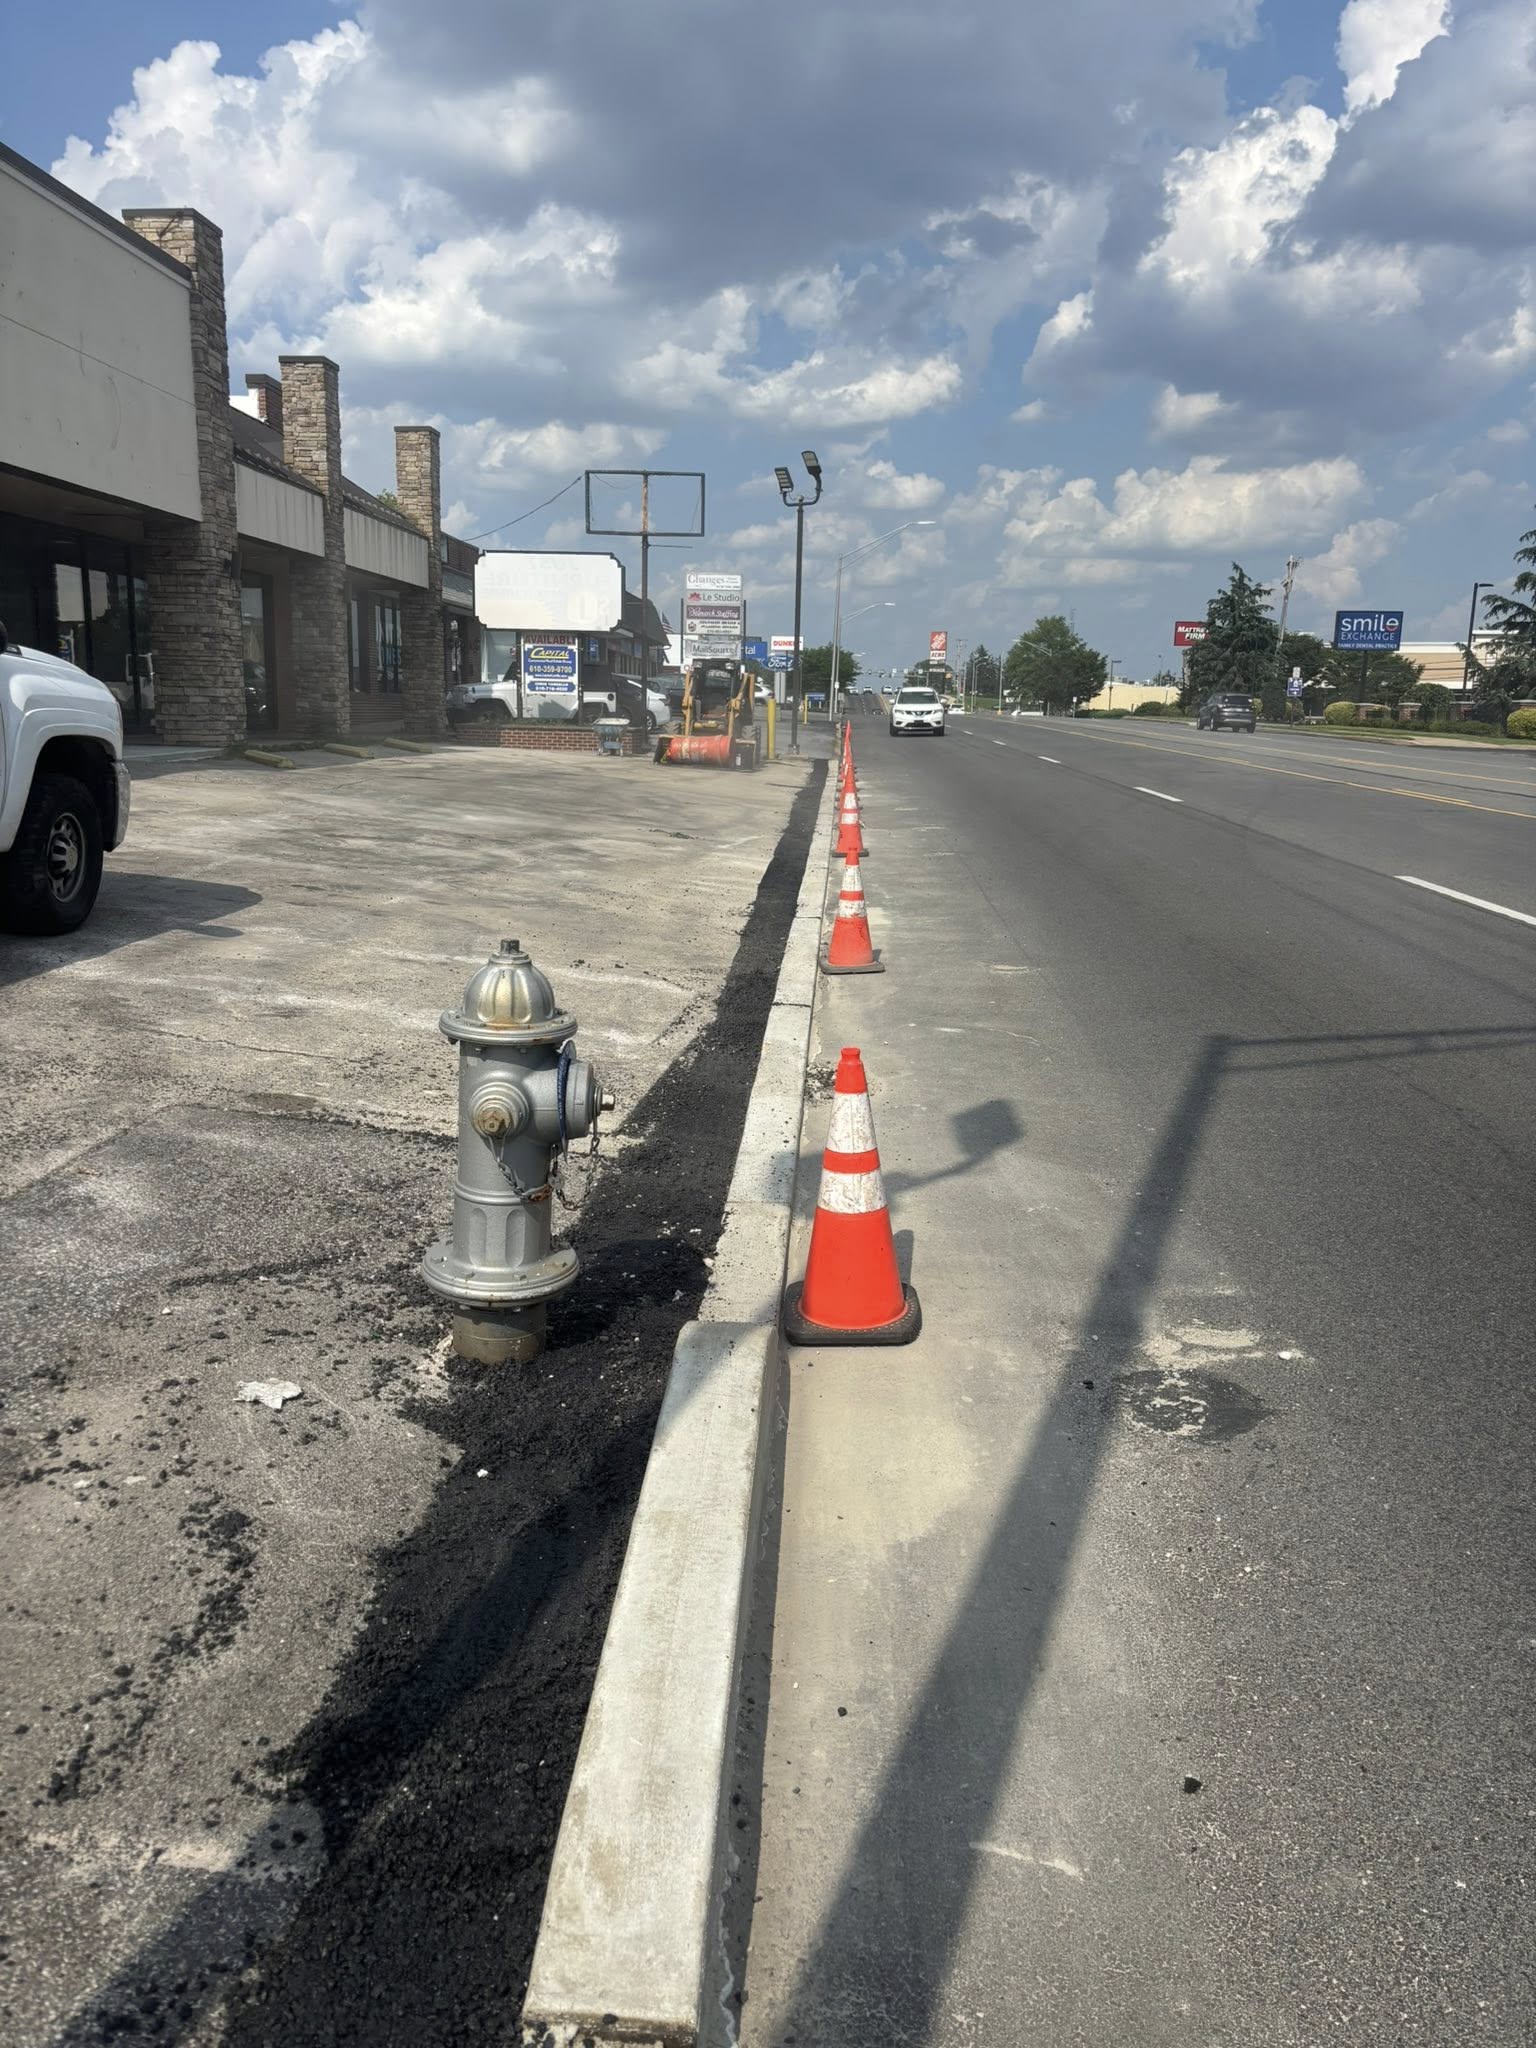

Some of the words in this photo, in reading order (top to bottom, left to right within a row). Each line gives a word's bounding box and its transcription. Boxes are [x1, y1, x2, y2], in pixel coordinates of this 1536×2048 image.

[688, 573, 724, 586] Changes
[703, 593, 712, 602] Le
[714, 592, 740, 602] Studio
[1341, 614, 1399, 632] smile
[1184, 632, 1206, 641] FIRM
[1341, 632, 1395, 641] EXCHANGE
[530, 647, 570, 660] CAPITAL
[692, 644, 735, 654] MailSource
[768, 656, 793, 668] Ford
